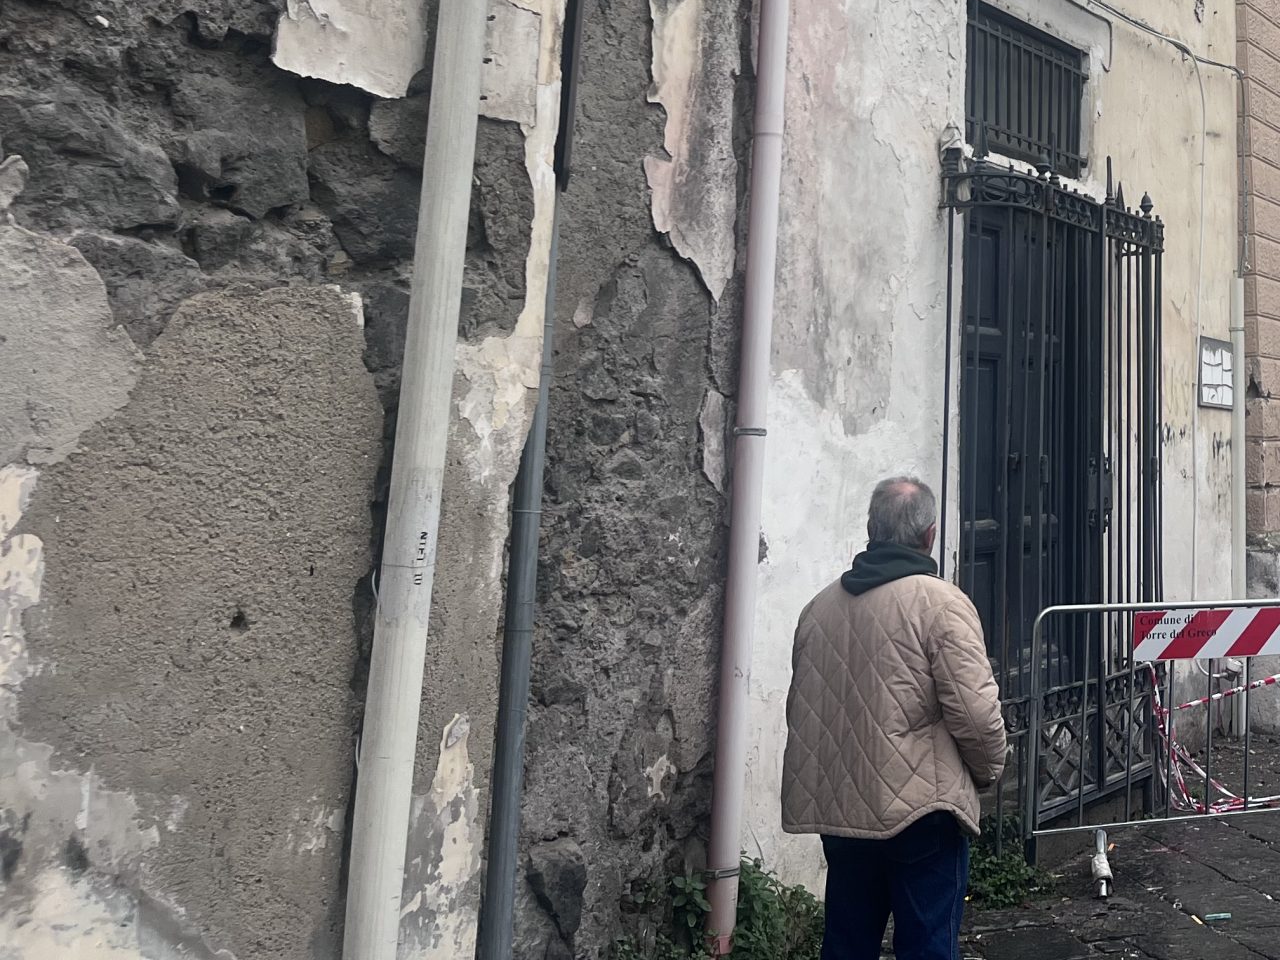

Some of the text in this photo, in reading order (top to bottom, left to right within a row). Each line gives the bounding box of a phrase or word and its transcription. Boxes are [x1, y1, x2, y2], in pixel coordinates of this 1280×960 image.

[1140, 614, 1194, 626] Comune di
[1141, 628, 1217, 640] Torre del Greco
